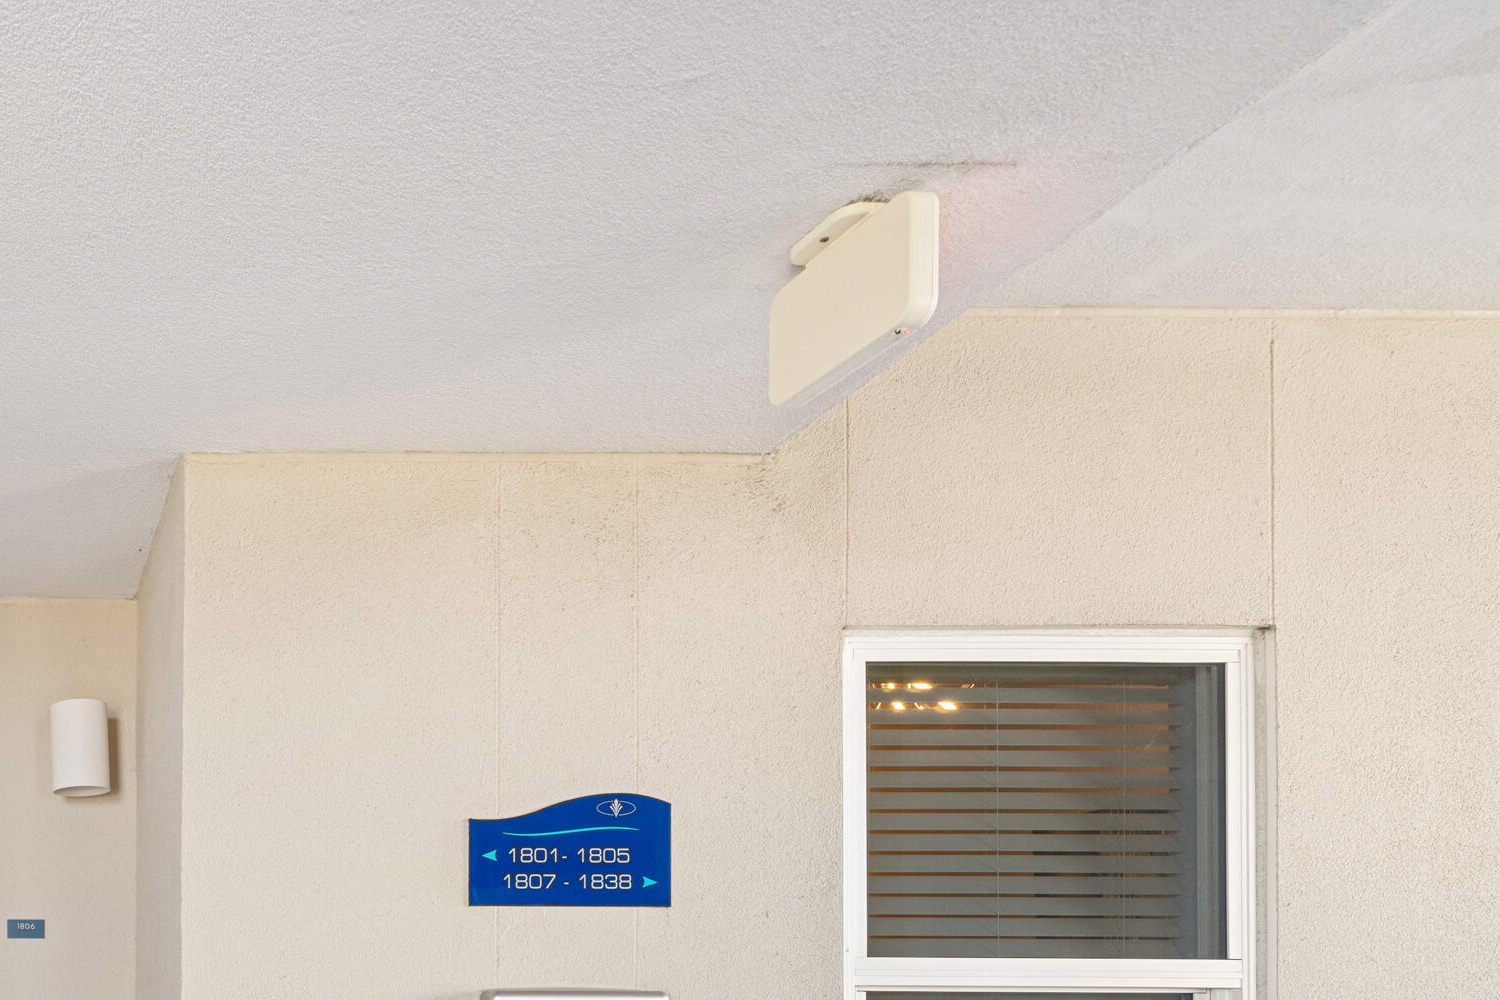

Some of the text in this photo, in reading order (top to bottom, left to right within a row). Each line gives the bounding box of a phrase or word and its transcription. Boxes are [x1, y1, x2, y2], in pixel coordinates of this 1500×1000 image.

[577, 847, 630, 864] 1805
[503, 873, 556, 890] 1807
[579, 873, 633, 890] 1838
